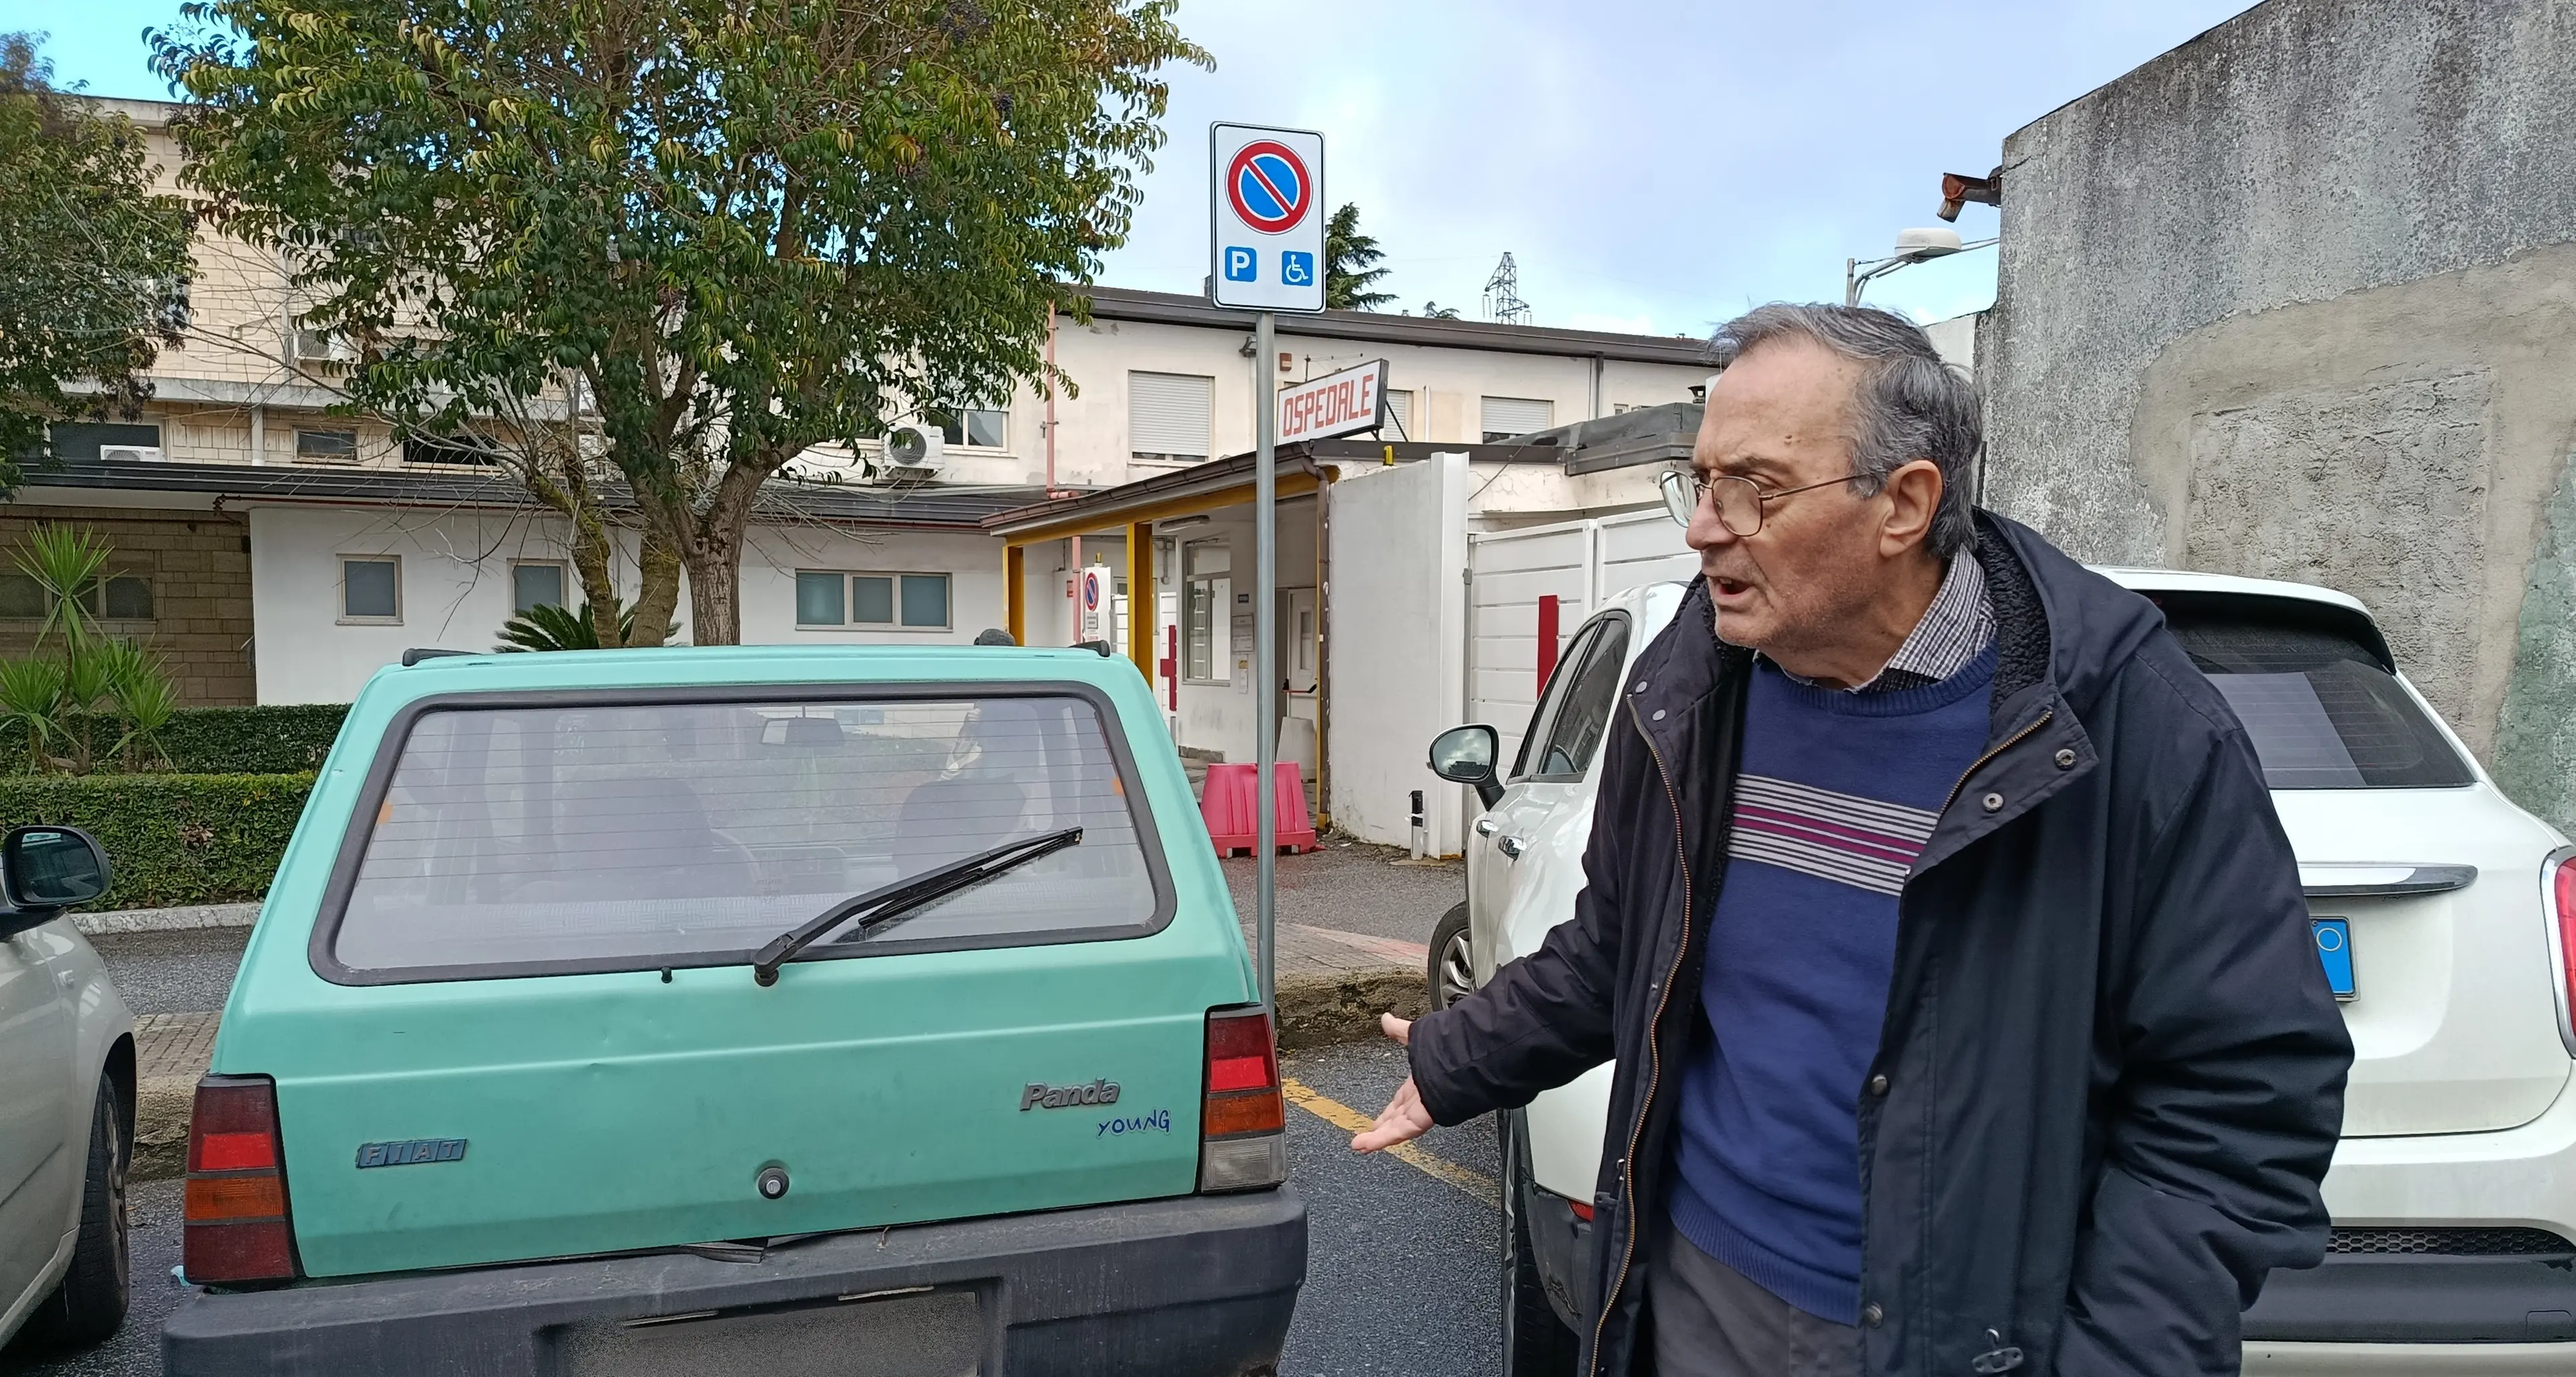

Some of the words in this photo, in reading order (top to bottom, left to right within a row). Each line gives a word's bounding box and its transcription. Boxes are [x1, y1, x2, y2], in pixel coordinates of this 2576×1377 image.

[1232, 250, 1250, 277] P
[1283, 374, 1375, 437] OSPEDALE
[1019, 1076, 1121, 1112] Panda
[1097, 1108, 1171, 1137] YOUNG
[366, 1141, 459, 1165] FIAT
